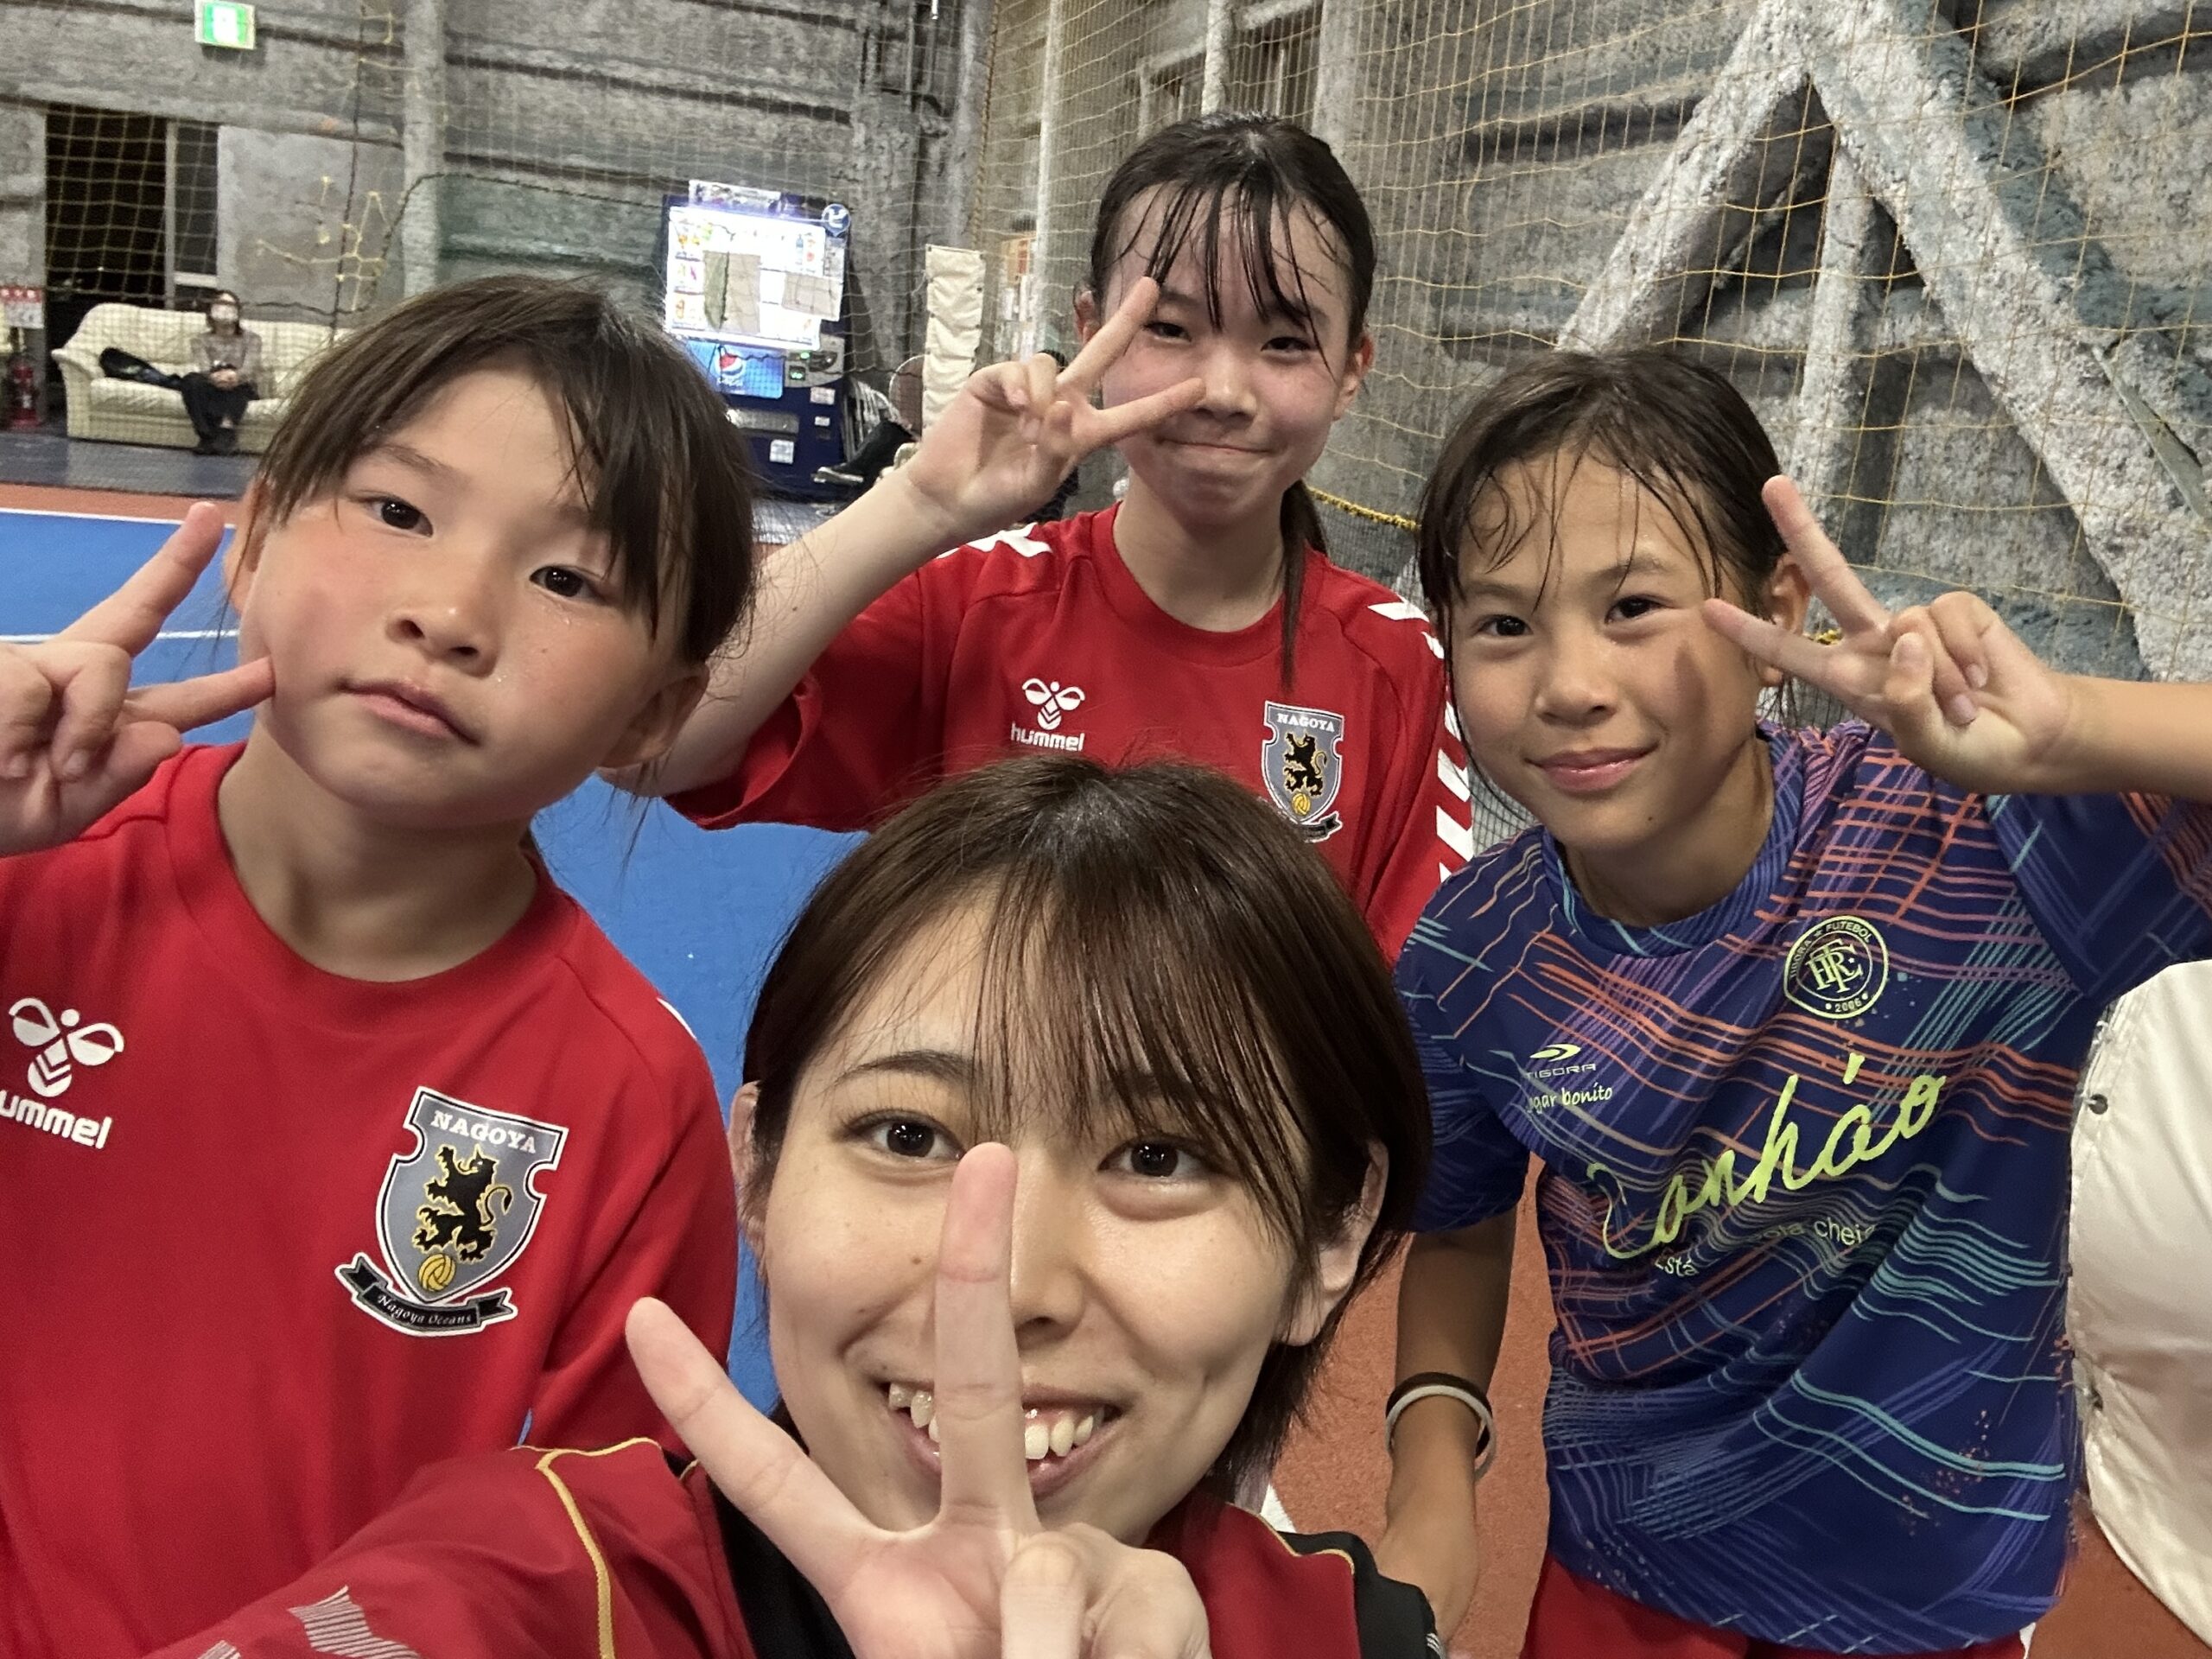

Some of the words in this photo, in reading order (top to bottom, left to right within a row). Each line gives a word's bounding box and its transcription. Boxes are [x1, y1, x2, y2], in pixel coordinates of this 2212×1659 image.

[1276, 713, 1335, 733] NAGOYA
[1010, 721, 1085, 752] hummel
[1826, 921, 1872, 943] FUTEBOL
[1526, 1064, 1597, 1079] TIGORA
[430, 1110, 537, 1154] NAGOYA
[378, 1295, 424, 1324] Nagoya
[428, 1314, 472, 1325] Oceans
